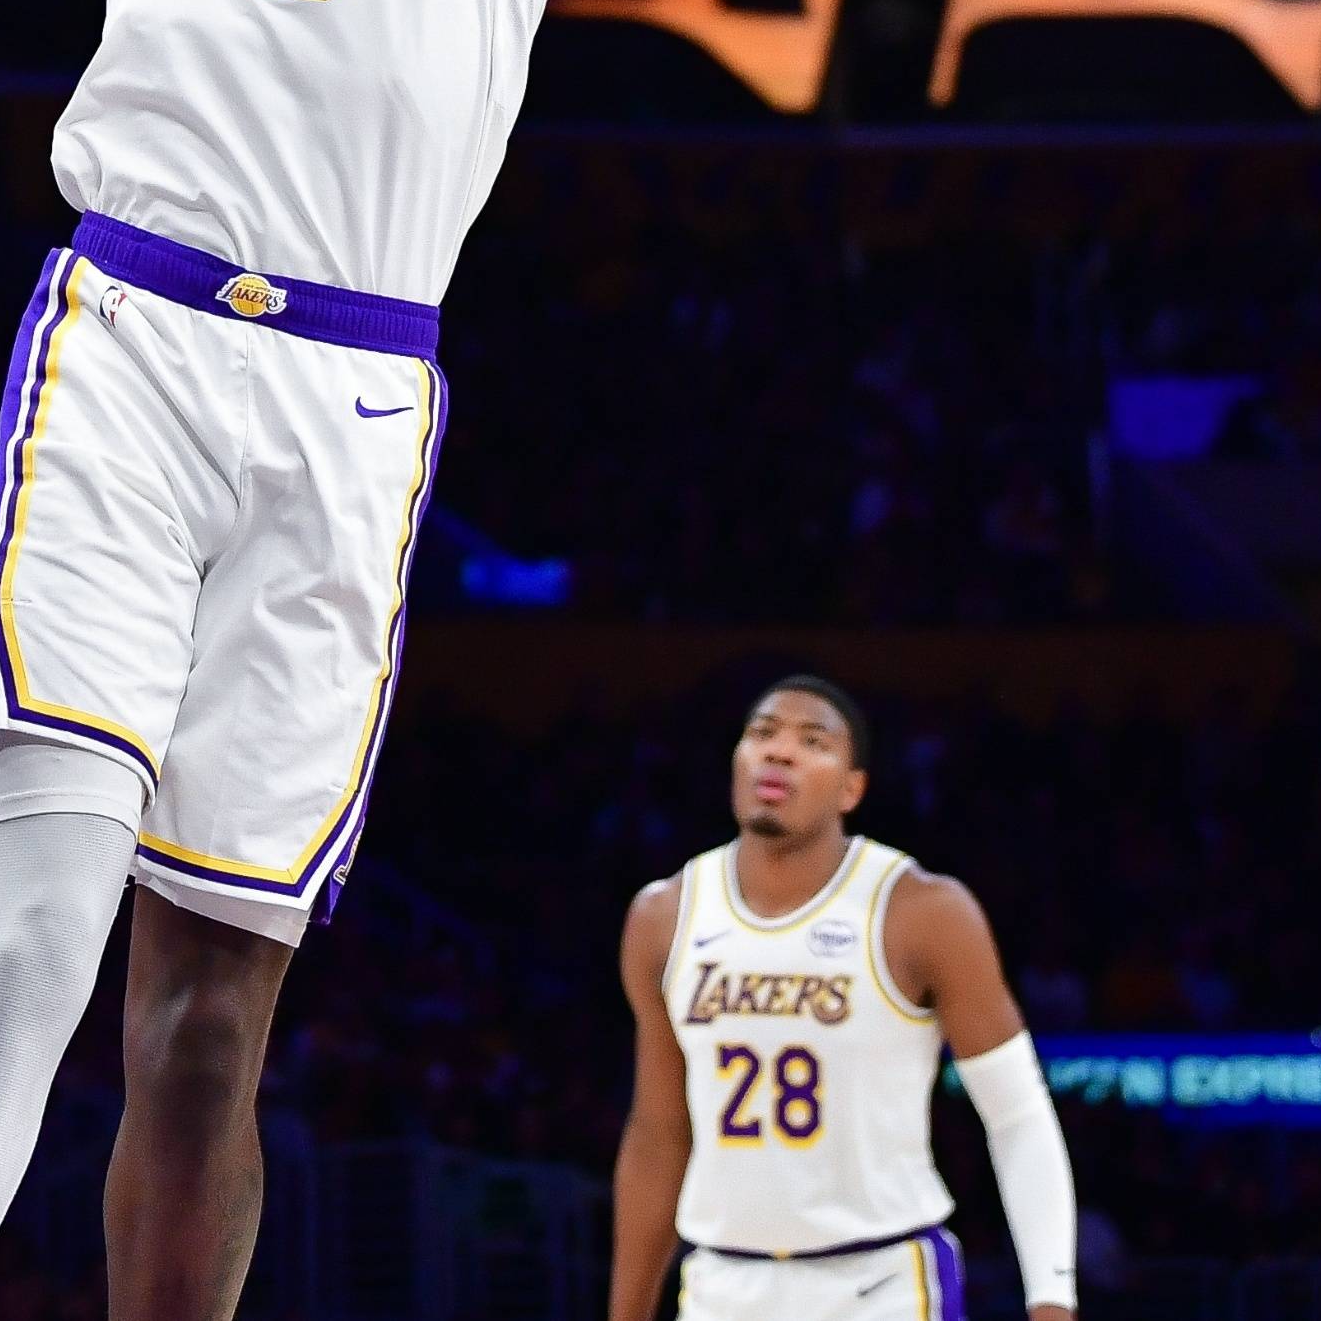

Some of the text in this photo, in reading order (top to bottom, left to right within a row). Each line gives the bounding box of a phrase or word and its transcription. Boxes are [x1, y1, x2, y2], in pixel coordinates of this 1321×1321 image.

[215, 280, 287, 314] LAKERS
[684, 961, 853, 1026] LAKERS
[716, 1043, 825, 1149] 28
